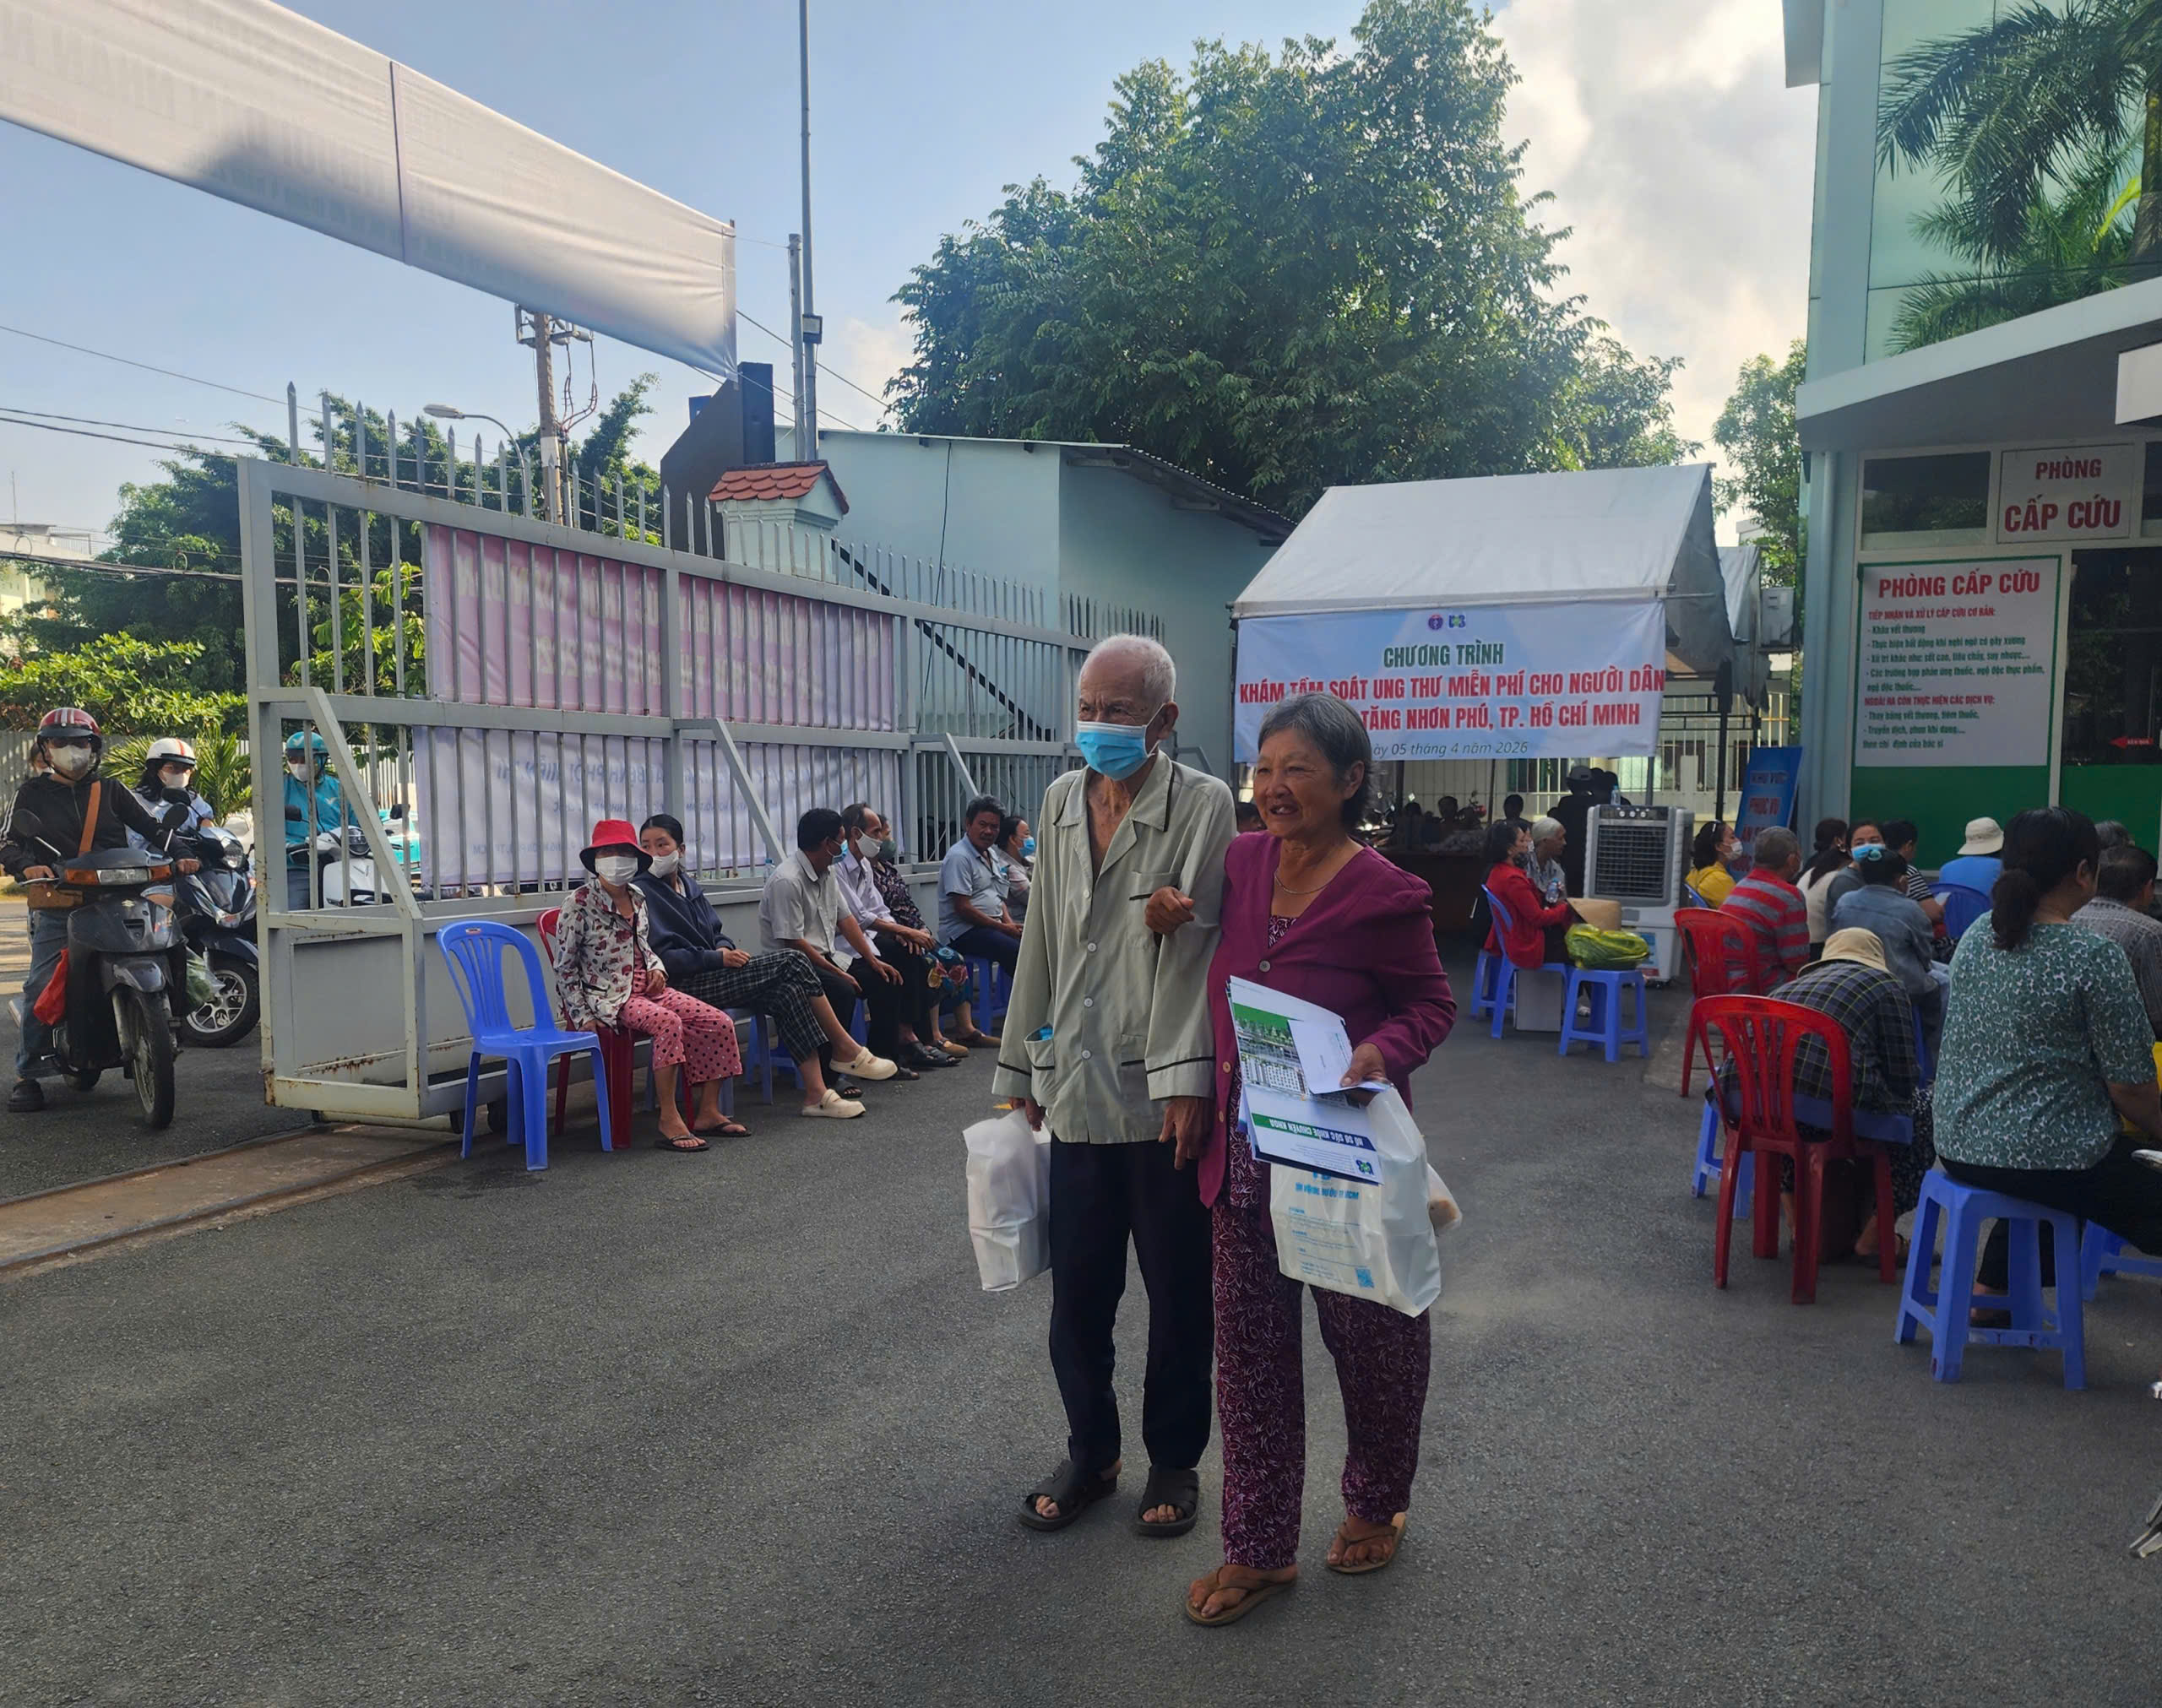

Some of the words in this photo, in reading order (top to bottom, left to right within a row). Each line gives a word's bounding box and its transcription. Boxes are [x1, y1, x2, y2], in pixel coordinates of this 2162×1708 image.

[2035, 455, 2102, 480] PHÒNG
[2005, 494, 2058, 532] CẤP
[2068, 493, 2121, 529] CỨU
[1878, 572, 1946, 598] PHÒNG
[1952, 567, 1992, 594] CẤP
[1999, 568, 2040, 594] CỨU
[1383, 644, 1450, 668] CHƯƠNG
[1456, 639, 1503, 664] TRÌNH
[1240, 679, 1285, 703] KHÁM
[1329, 675, 1369, 700] SOÁT
[1373, 678, 1405, 699] UNG
[1410, 675, 1442, 697] THƯ
[1448, 670, 1491, 697] MIỄN
[1496, 670, 1524, 696] PHÍ
[1529, 673, 1563, 696] CHO
[1569, 666, 1623, 694] NGƯỜI
[1629, 664, 1665, 692] DÂN
[1361, 706, 1401, 729] TĂNG
[1406, 706, 1450, 729] NHƠN
[1455, 702, 1493, 730] PHÚ,
[1499, 706, 1524, 728] TP.
[1530, 701, 1554, 727] HỒ
[1558, 700, 1588, 726] CHÍ
[1593, 703, 1640, 725] MINH
[1391, 743, 1406, 756] 05
[1410, 742, 1446, 758] tháng
[1450, 742, 1459, 753] 4
[1462, 742, 1491, 754] năm
[1495, 741, 1528, 754] 2026
